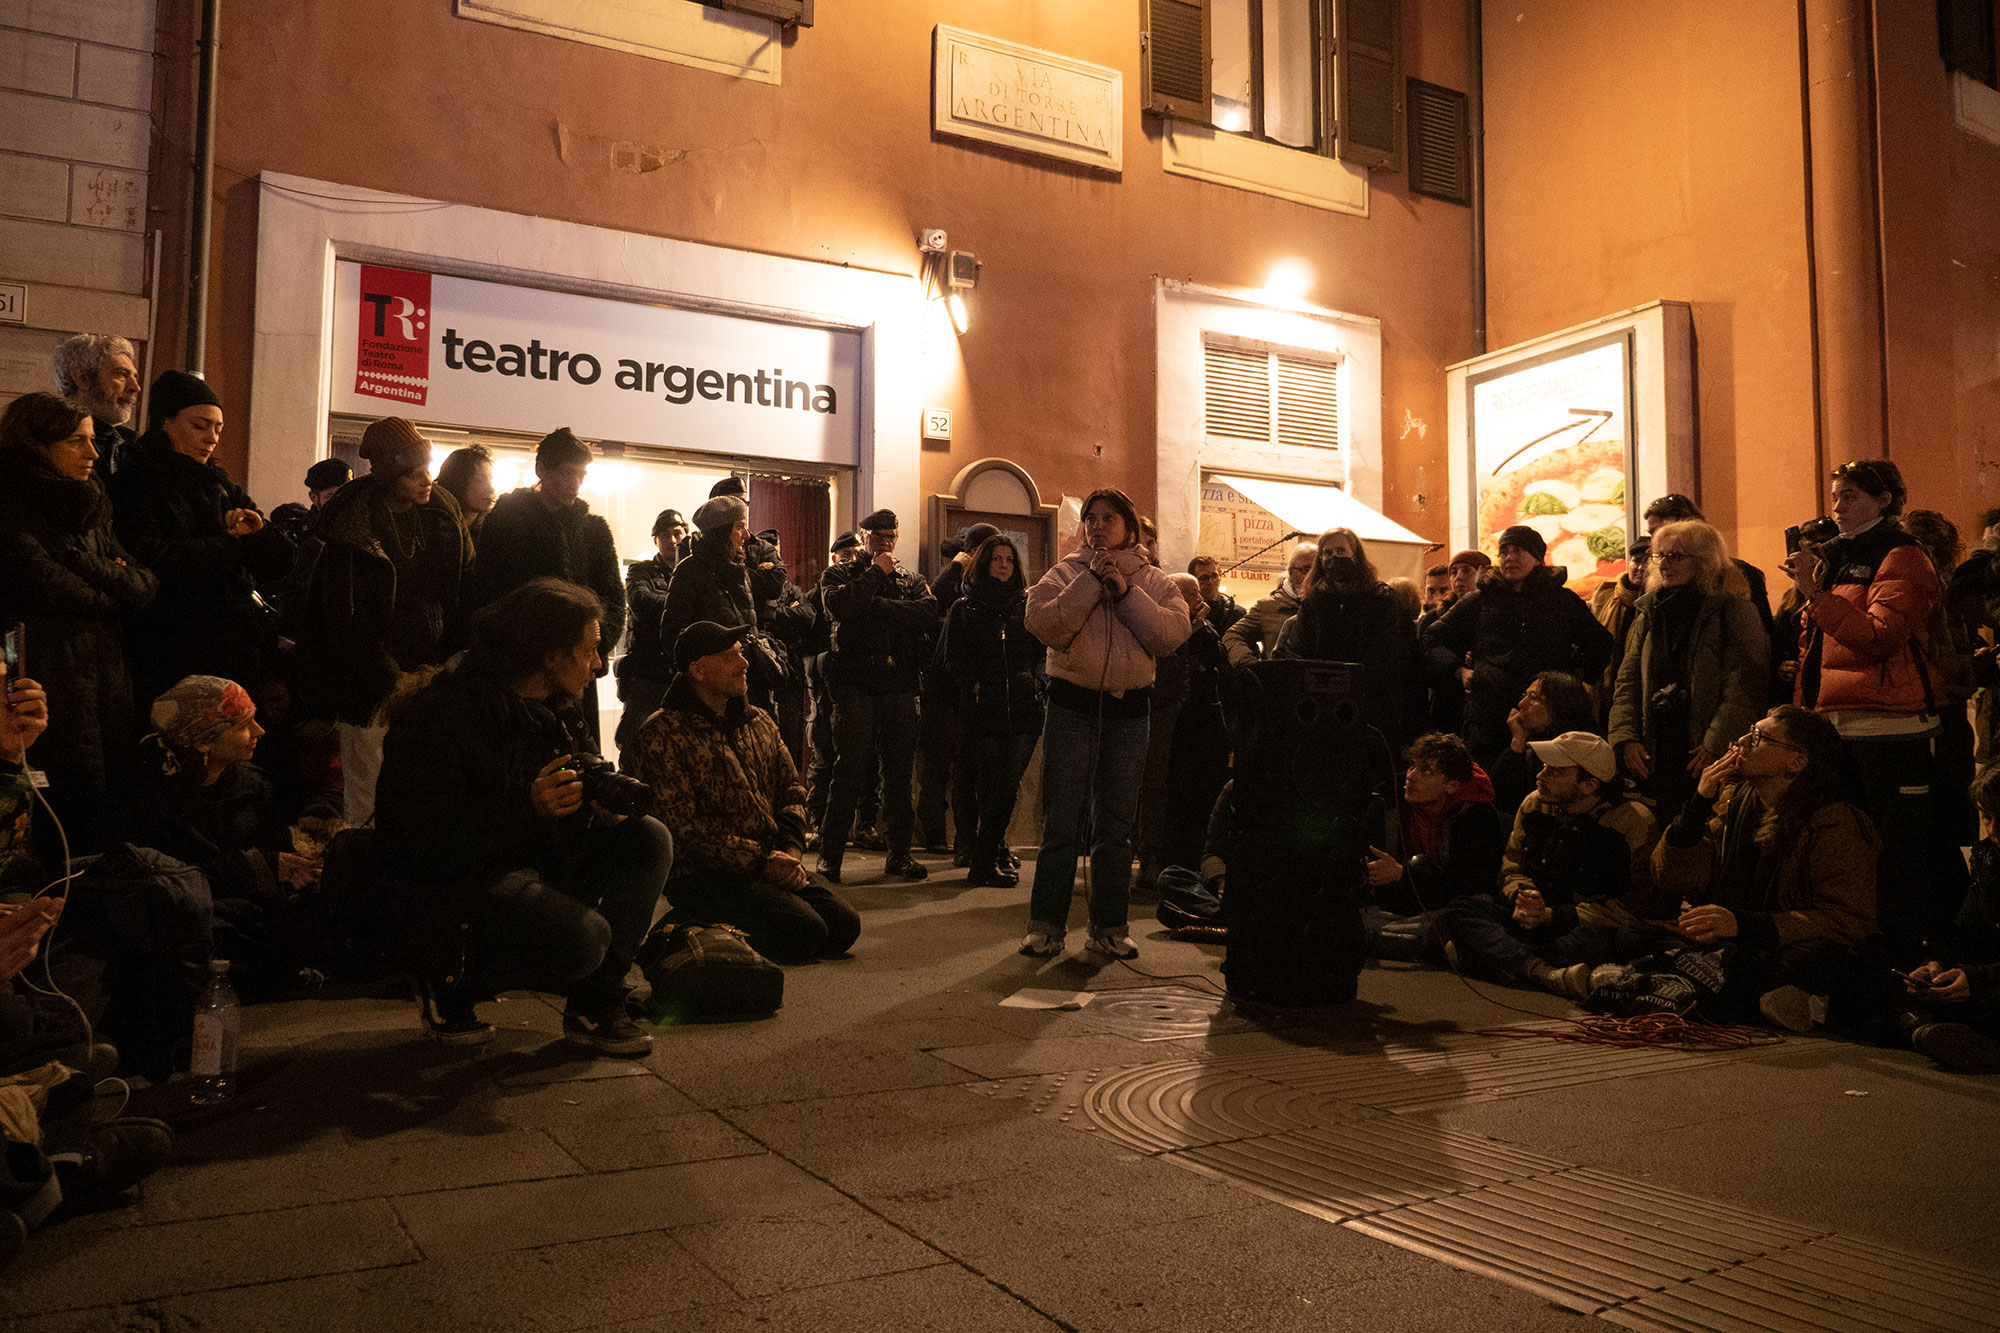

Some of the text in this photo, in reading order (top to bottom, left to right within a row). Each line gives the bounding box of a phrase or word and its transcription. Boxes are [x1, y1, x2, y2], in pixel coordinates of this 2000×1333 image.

[1015, 63, 1053, 90] VIA
[989, 82, 1007, 99] DI
[1016, 88, 1076, 115] TORRE
[956, 97, 1106, 147] ARGENTINA
[362, 339, 424, 354] Fondazione
[362, 349, 396, 360] Teatro
[361, 358, 404, 371] di Roma
[442, 328, 837, 415] teatro argentina
[359, 380, 422, 400] Argentina
[1491, 364, 1603, 412] ROSSOPOMODO
[930, 416, 948, 432] 52
[1227, 490, 1235, 503] e
[1243, 515, 1274, 532] pizza
